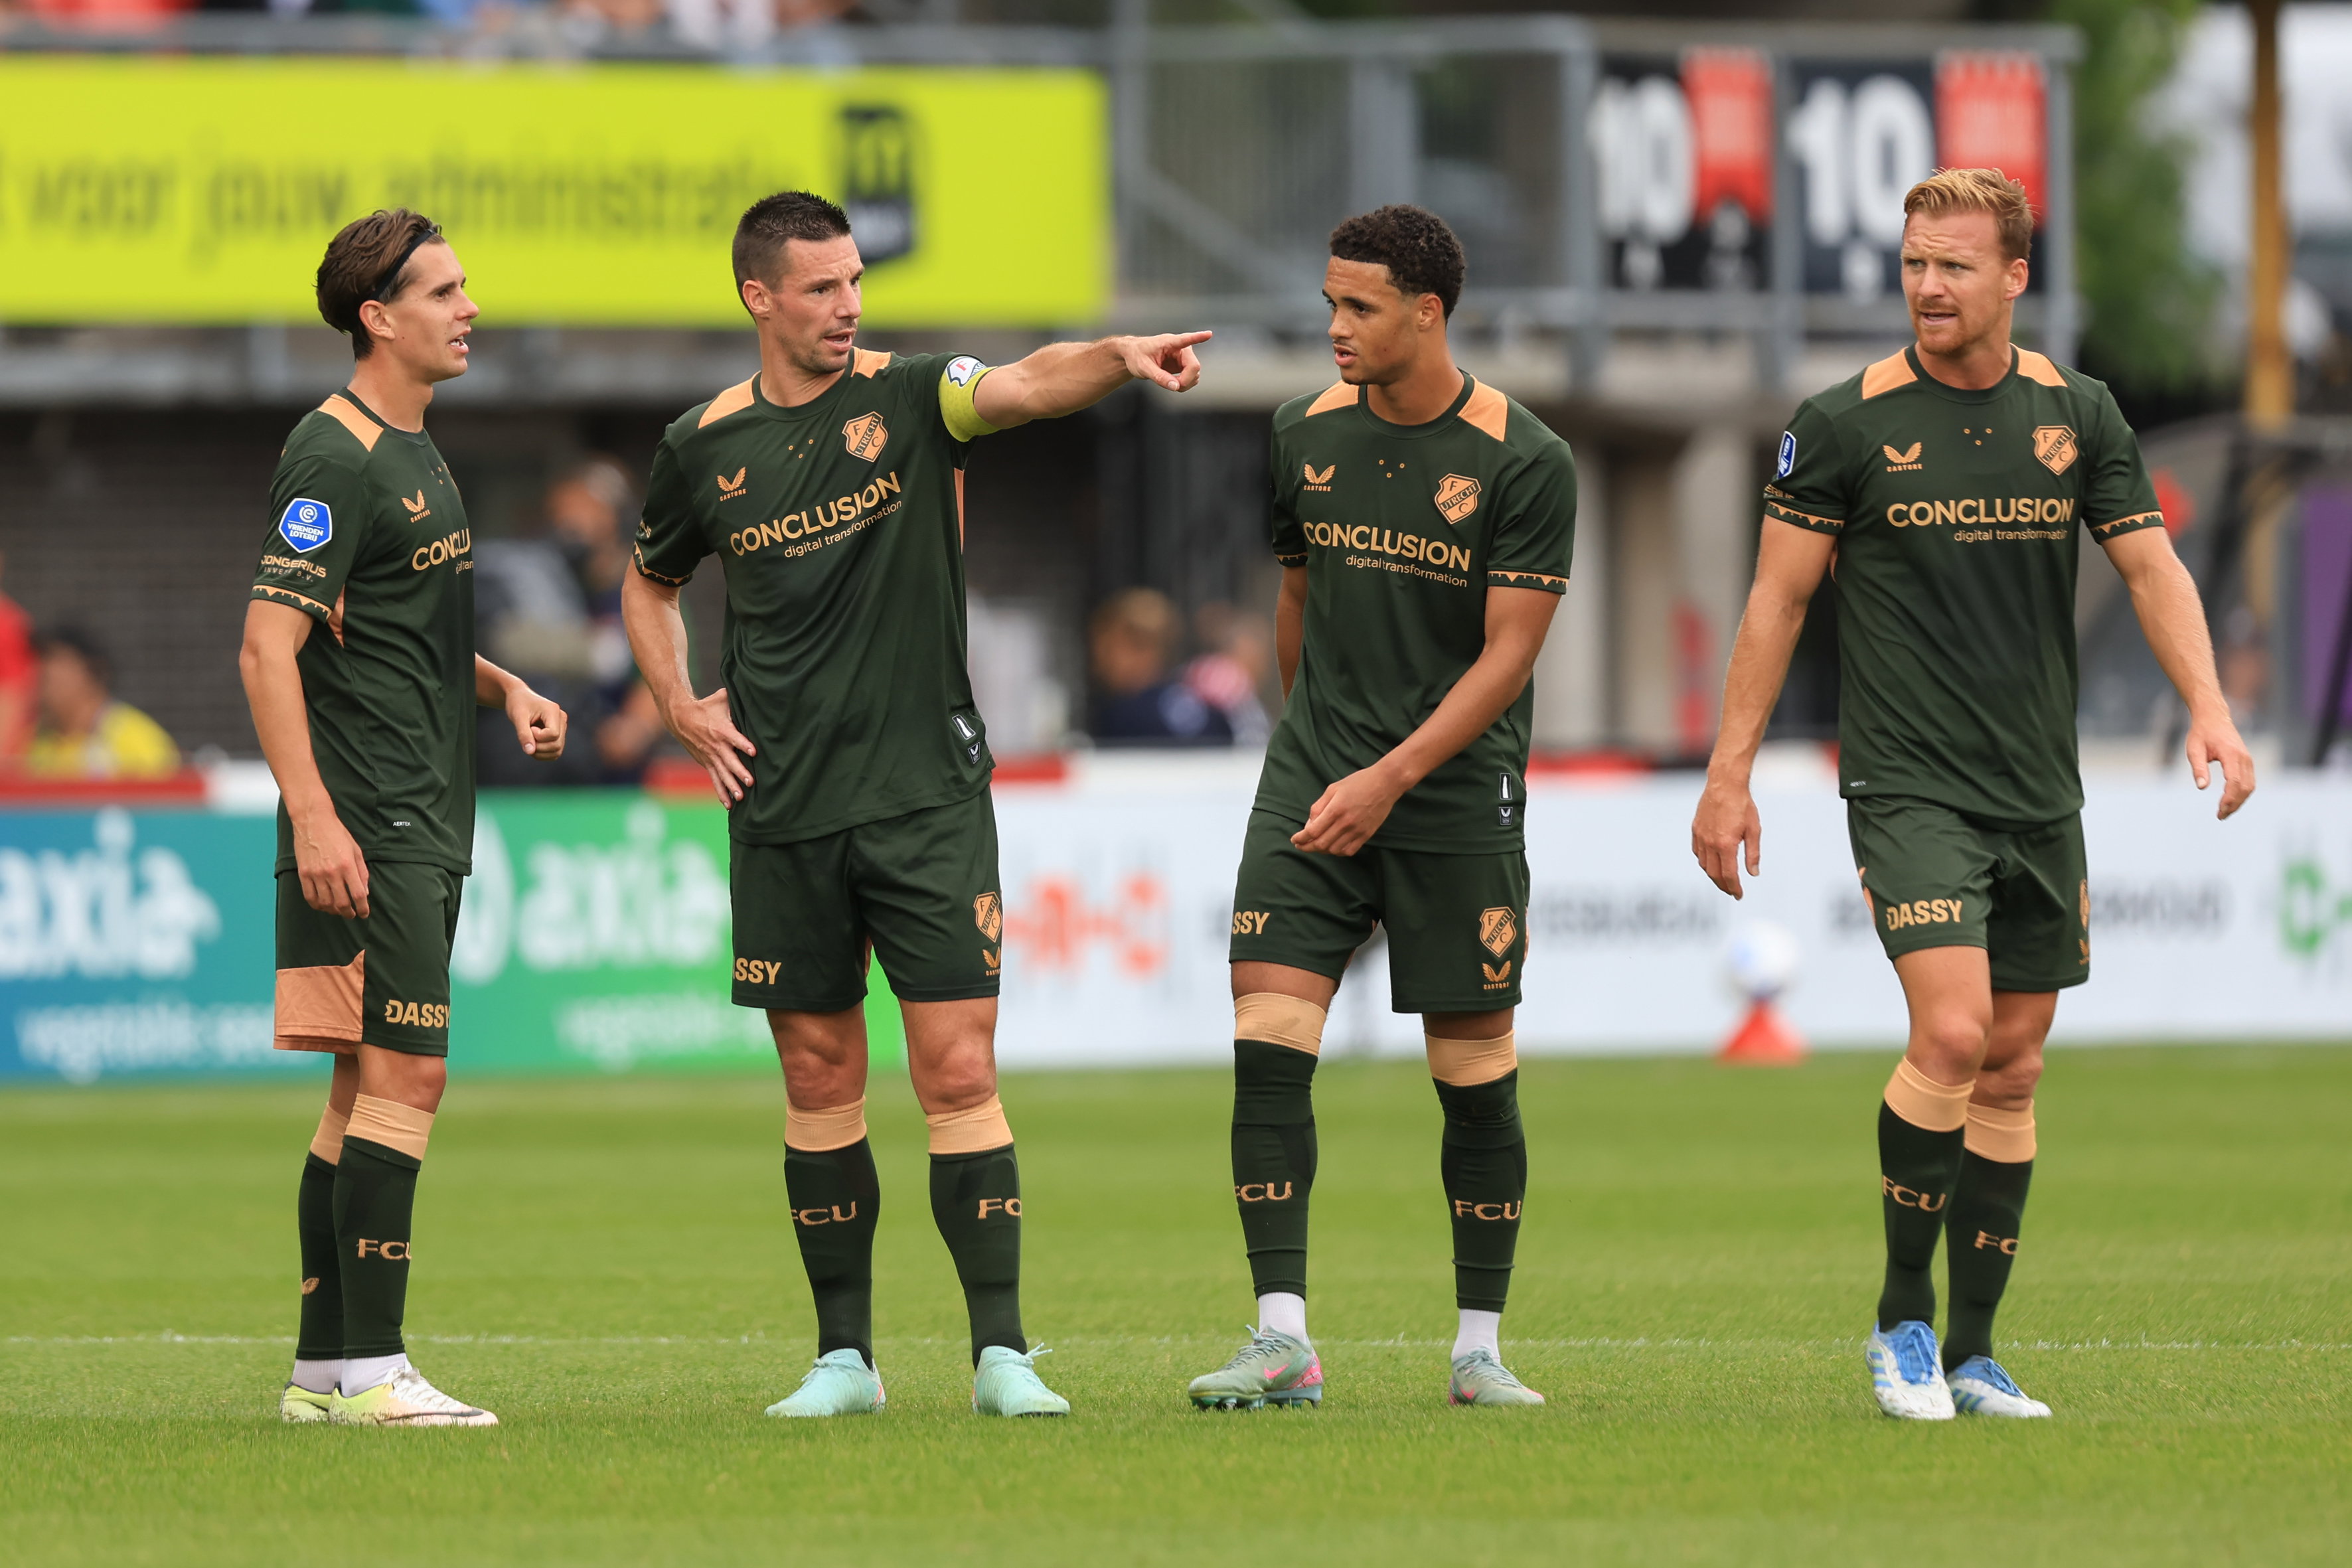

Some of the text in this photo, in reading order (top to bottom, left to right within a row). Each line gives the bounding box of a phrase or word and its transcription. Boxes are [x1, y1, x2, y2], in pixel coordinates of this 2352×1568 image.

[853, 424, 860, 436] F
[854, 416, 879, 455] UTRECHT
[872, 436, 881, 447] C
[2042, 430, 2071, 463] UTRECHT
[1886, 463, 1922, 472] CASTORE
[720, 488, 746, 502] CASTORE
[1440, 483, 1477, 510] UTRECHT
[1449, 481, 1458, 491] F
[730, 471, 902, 556] CONCLUSION
[1458, 503, 1468, 513] C
[1887, 498, 2075, 528] CONCLUSION
[287, 522, 324, 536] VRIENDEN
[784, 500, 902, 558] digital transformation
[1954, 529, 1992, 543] digital
[1303, 522, 1471, 572] CONCLUSION
[261, 555, 327, 578] JONGERIUS
[1346, 554, 1467, 588] digital transformation
[982, 898, 998, 933] UTRECHT
[1885, 898, 1962, 931] DASSY
[1486, 911, 1511, 947] UTRECHT
[733, 957, 782, 985] SSY
[384, 999, 450, 1029] DASSY
[1454, 1200, 1522, 1220] FCU
